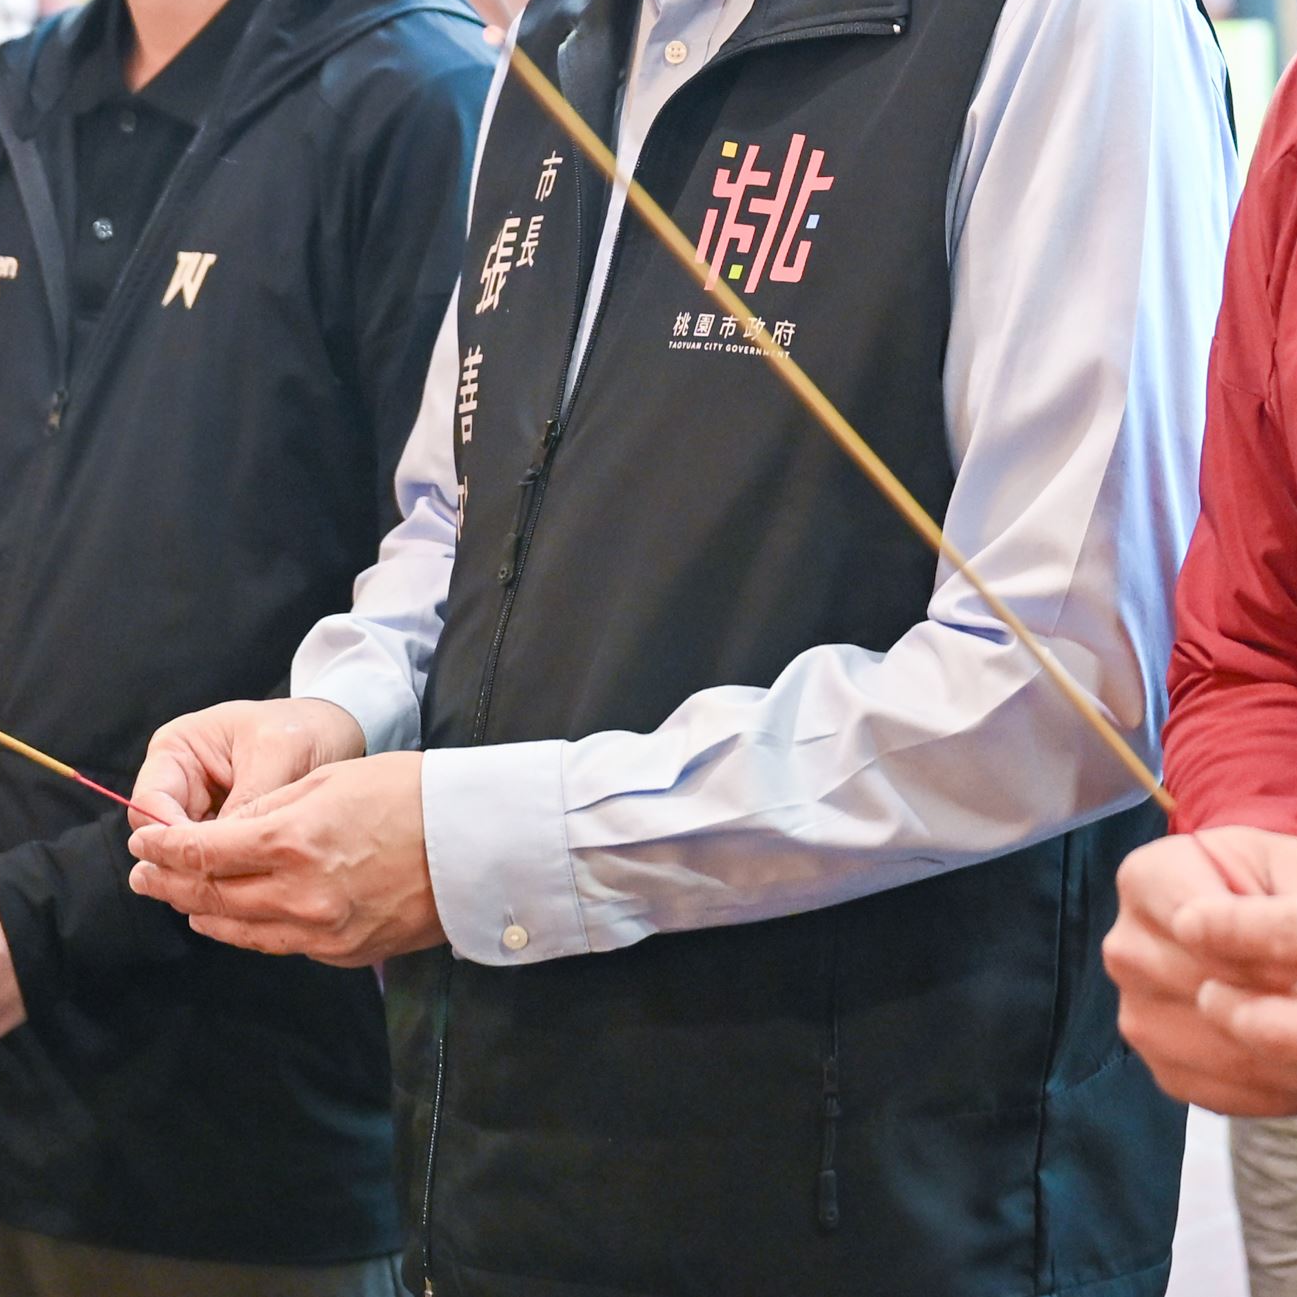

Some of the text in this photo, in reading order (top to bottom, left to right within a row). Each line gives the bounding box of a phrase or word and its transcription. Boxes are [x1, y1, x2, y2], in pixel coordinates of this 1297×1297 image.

[515, 150, 564, 267] 市長
[672, 312, 797, 347] 桃園市政府
[668, 340, 791, 359] TAOYUAN CITY GOVERNNT
